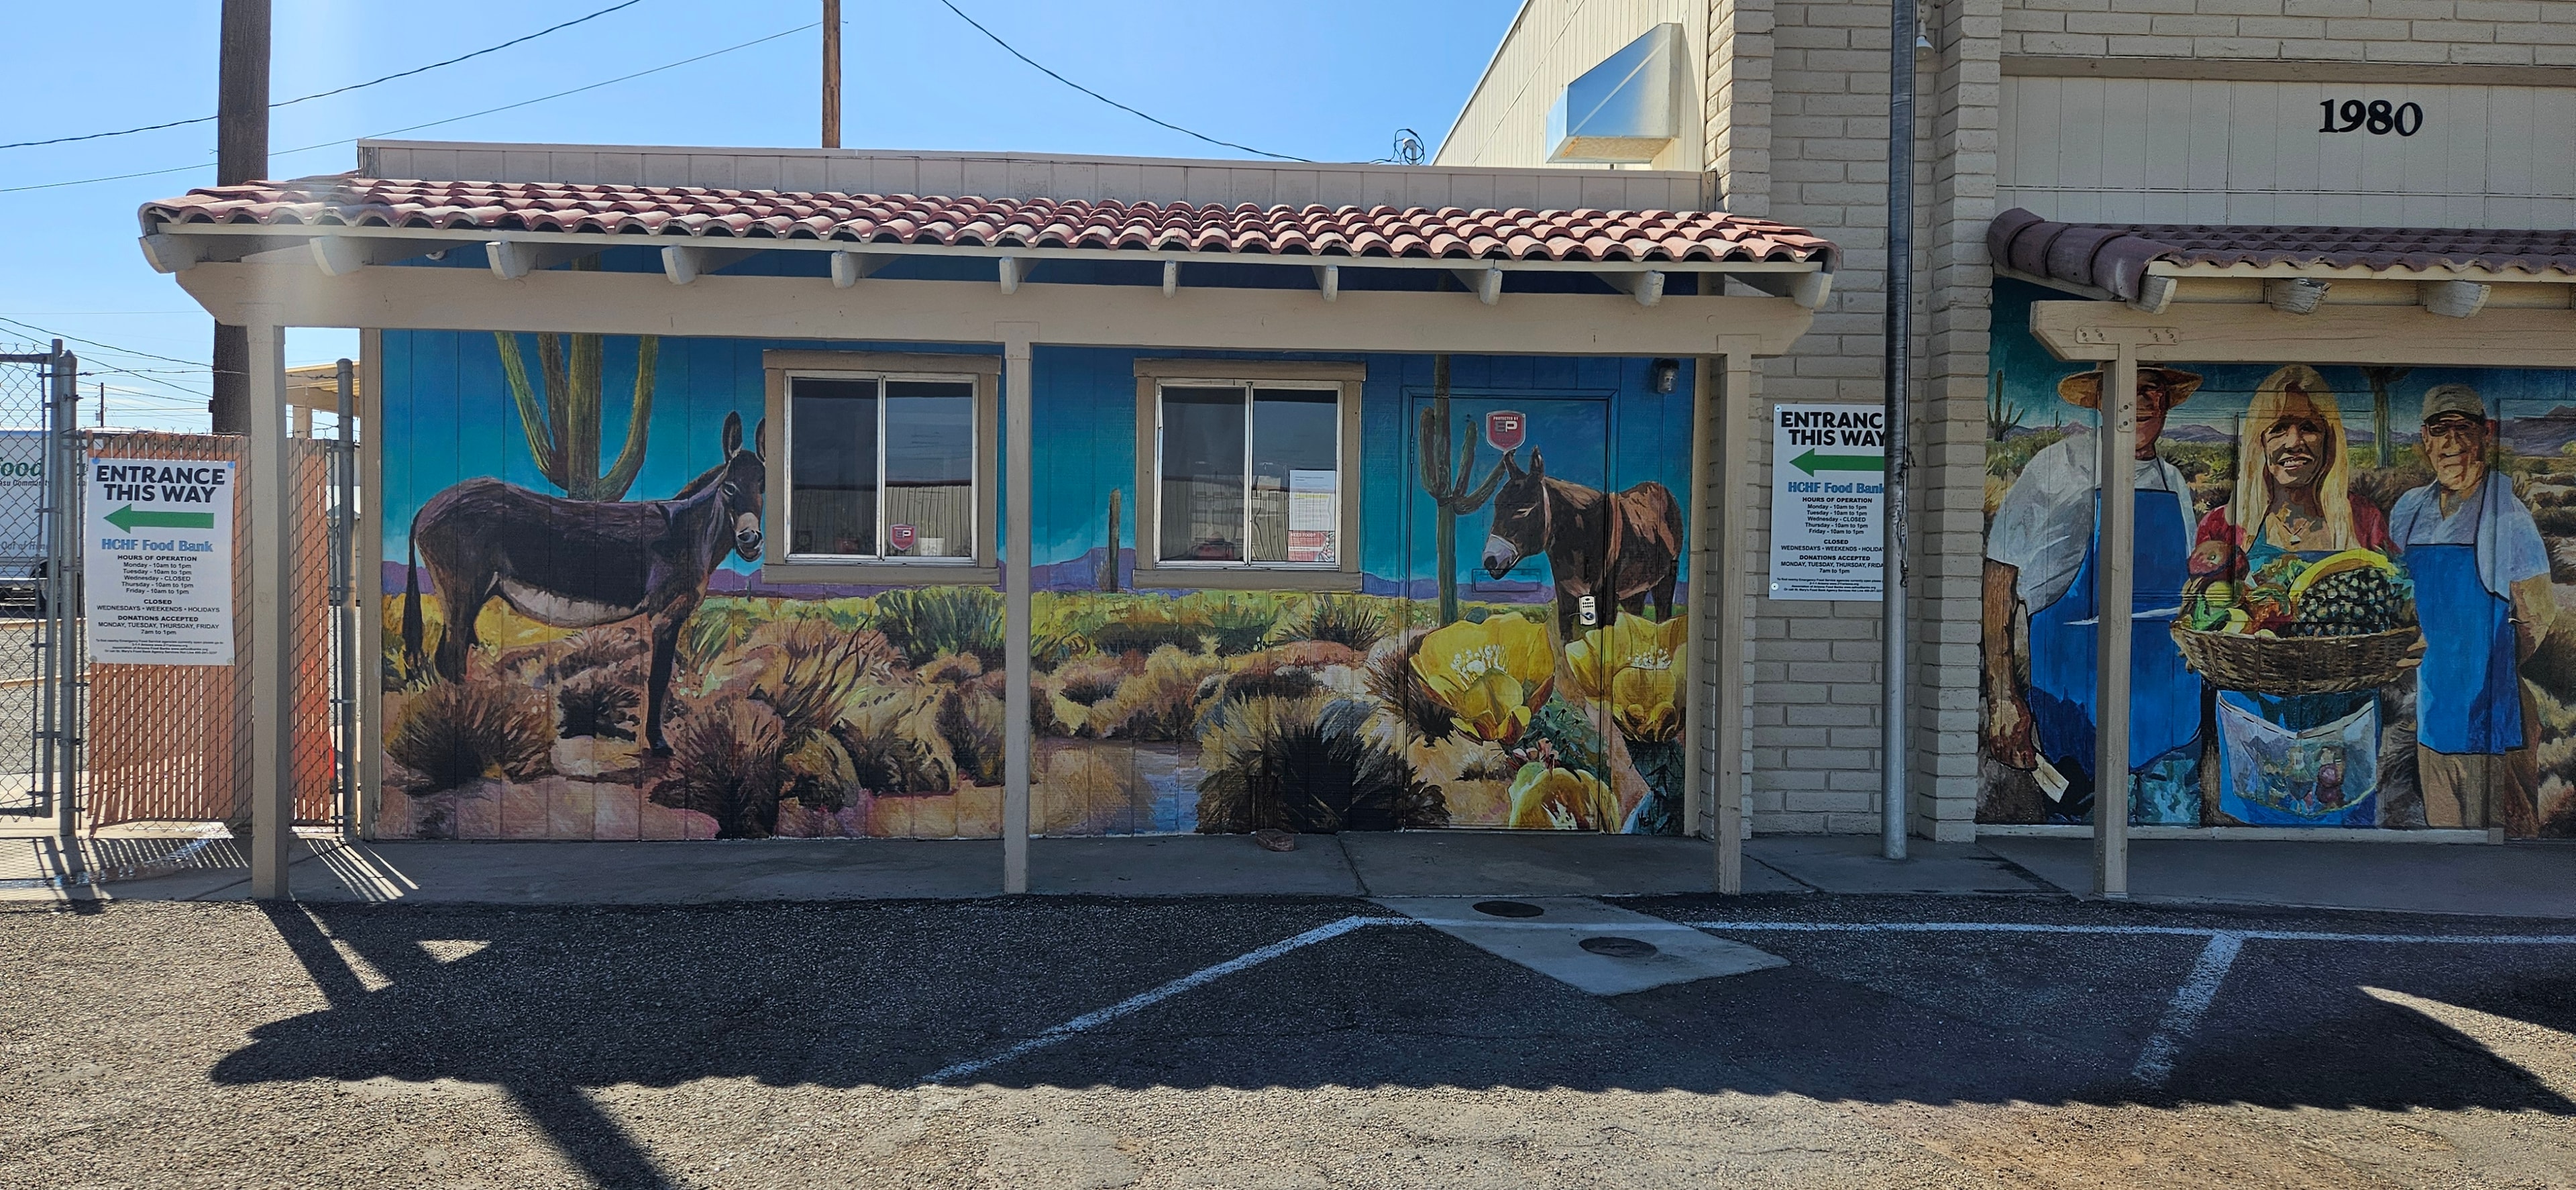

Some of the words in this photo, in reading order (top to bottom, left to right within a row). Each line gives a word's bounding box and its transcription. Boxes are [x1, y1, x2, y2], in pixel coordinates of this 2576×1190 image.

[2319, 99, 2423, 136] 1980
[1781, 411, 1882, 429] ENTRANC
[1788, 429, 1835, 445] THIS
[1840, 430, 1884, 446] WAY
[96, 465, 225, 484] ENTRANCE
[103, 484, 155, 501] THIS
[161, 485, 216, 502] WAY
[1788, 482, 1821, 492] HCHF
[1824, 482, 1852, 493] Food
[102, 539, 138, 549] HCHF
[142, 539, 174, 551] Food
[178, 540, 213, 551] Bank
